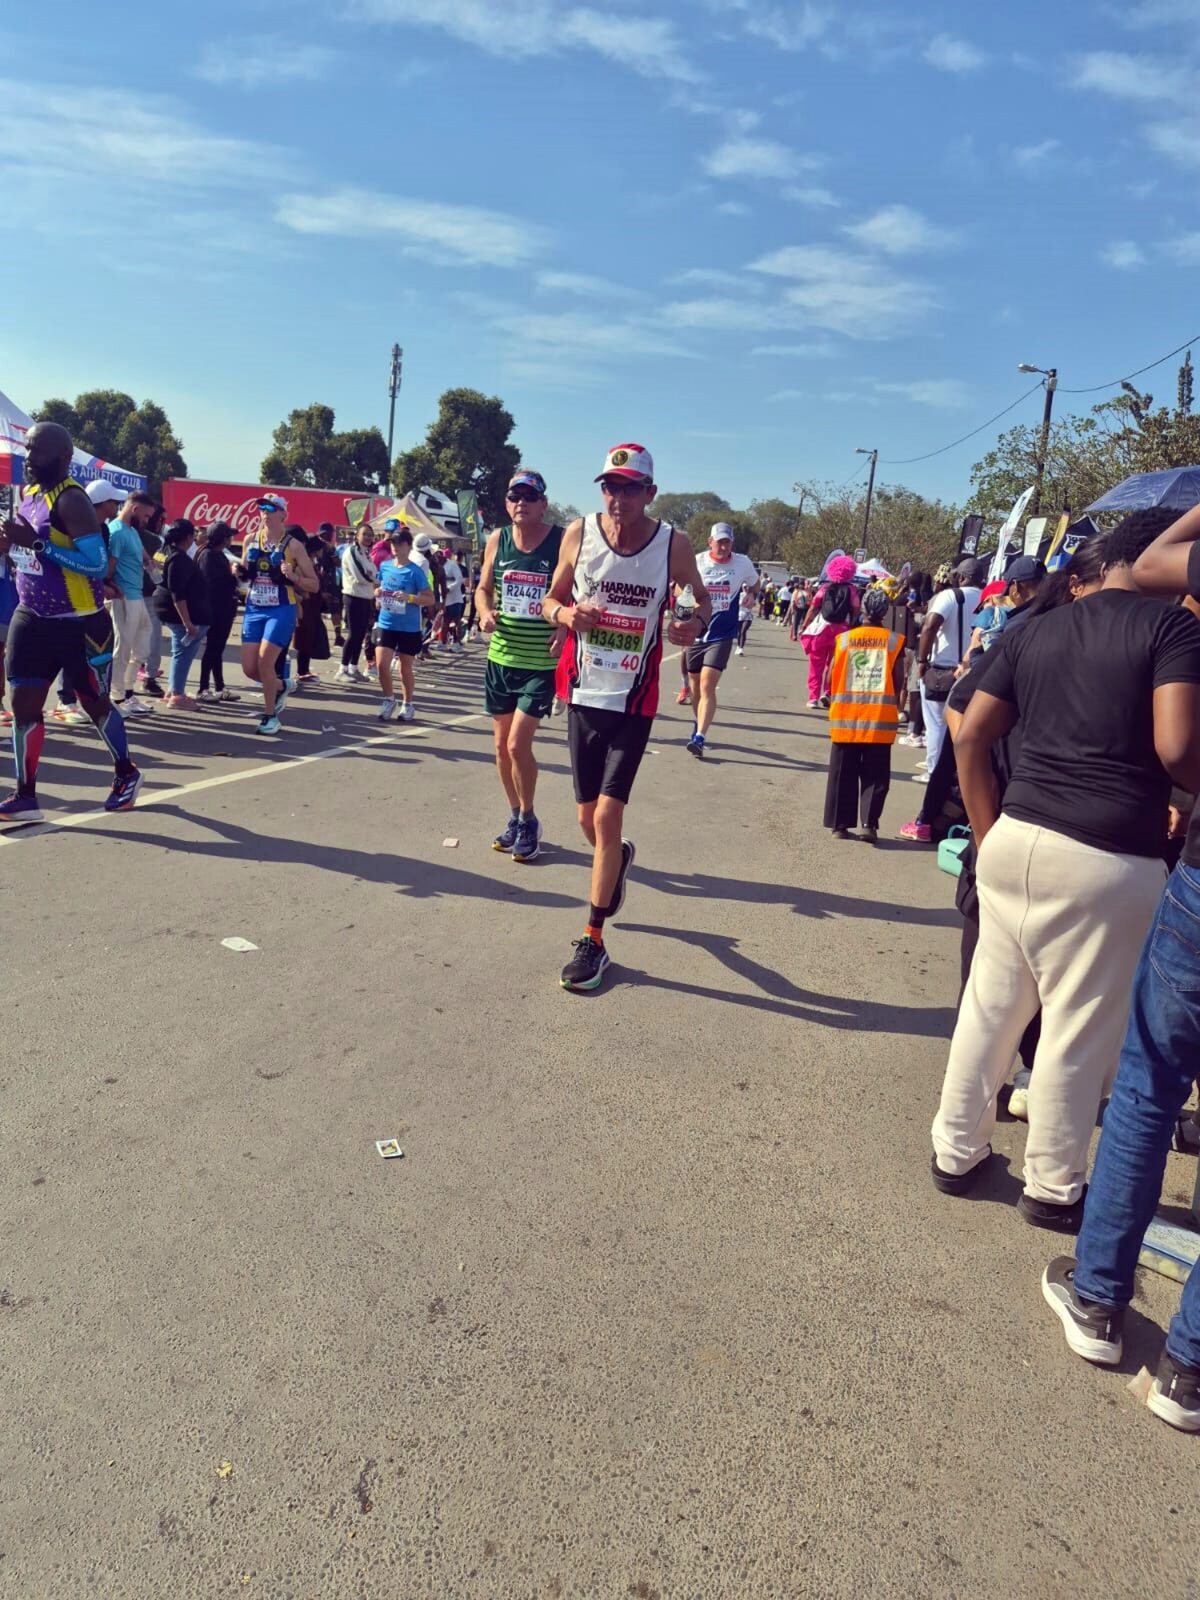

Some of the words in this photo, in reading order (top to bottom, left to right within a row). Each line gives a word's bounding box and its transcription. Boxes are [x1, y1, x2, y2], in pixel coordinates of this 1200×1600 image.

[80, 464, 118, 484] ATHLETIC
[120, 474, 140, 489] CLUB
[183, 493, 261, 533] Coca-Co
[28, 560, 40, 571] 40
[506, 585, 542, 600] R24421
[600, 581, 657, 599] HARMONY
[528, 602, 543, 616] 60
[606, 594, 648, 608] Striders
[599, 615, 642, 629] HIRSTI
[589, 628, 641, 652] H34389
[620, 654, 640, 671] 40
